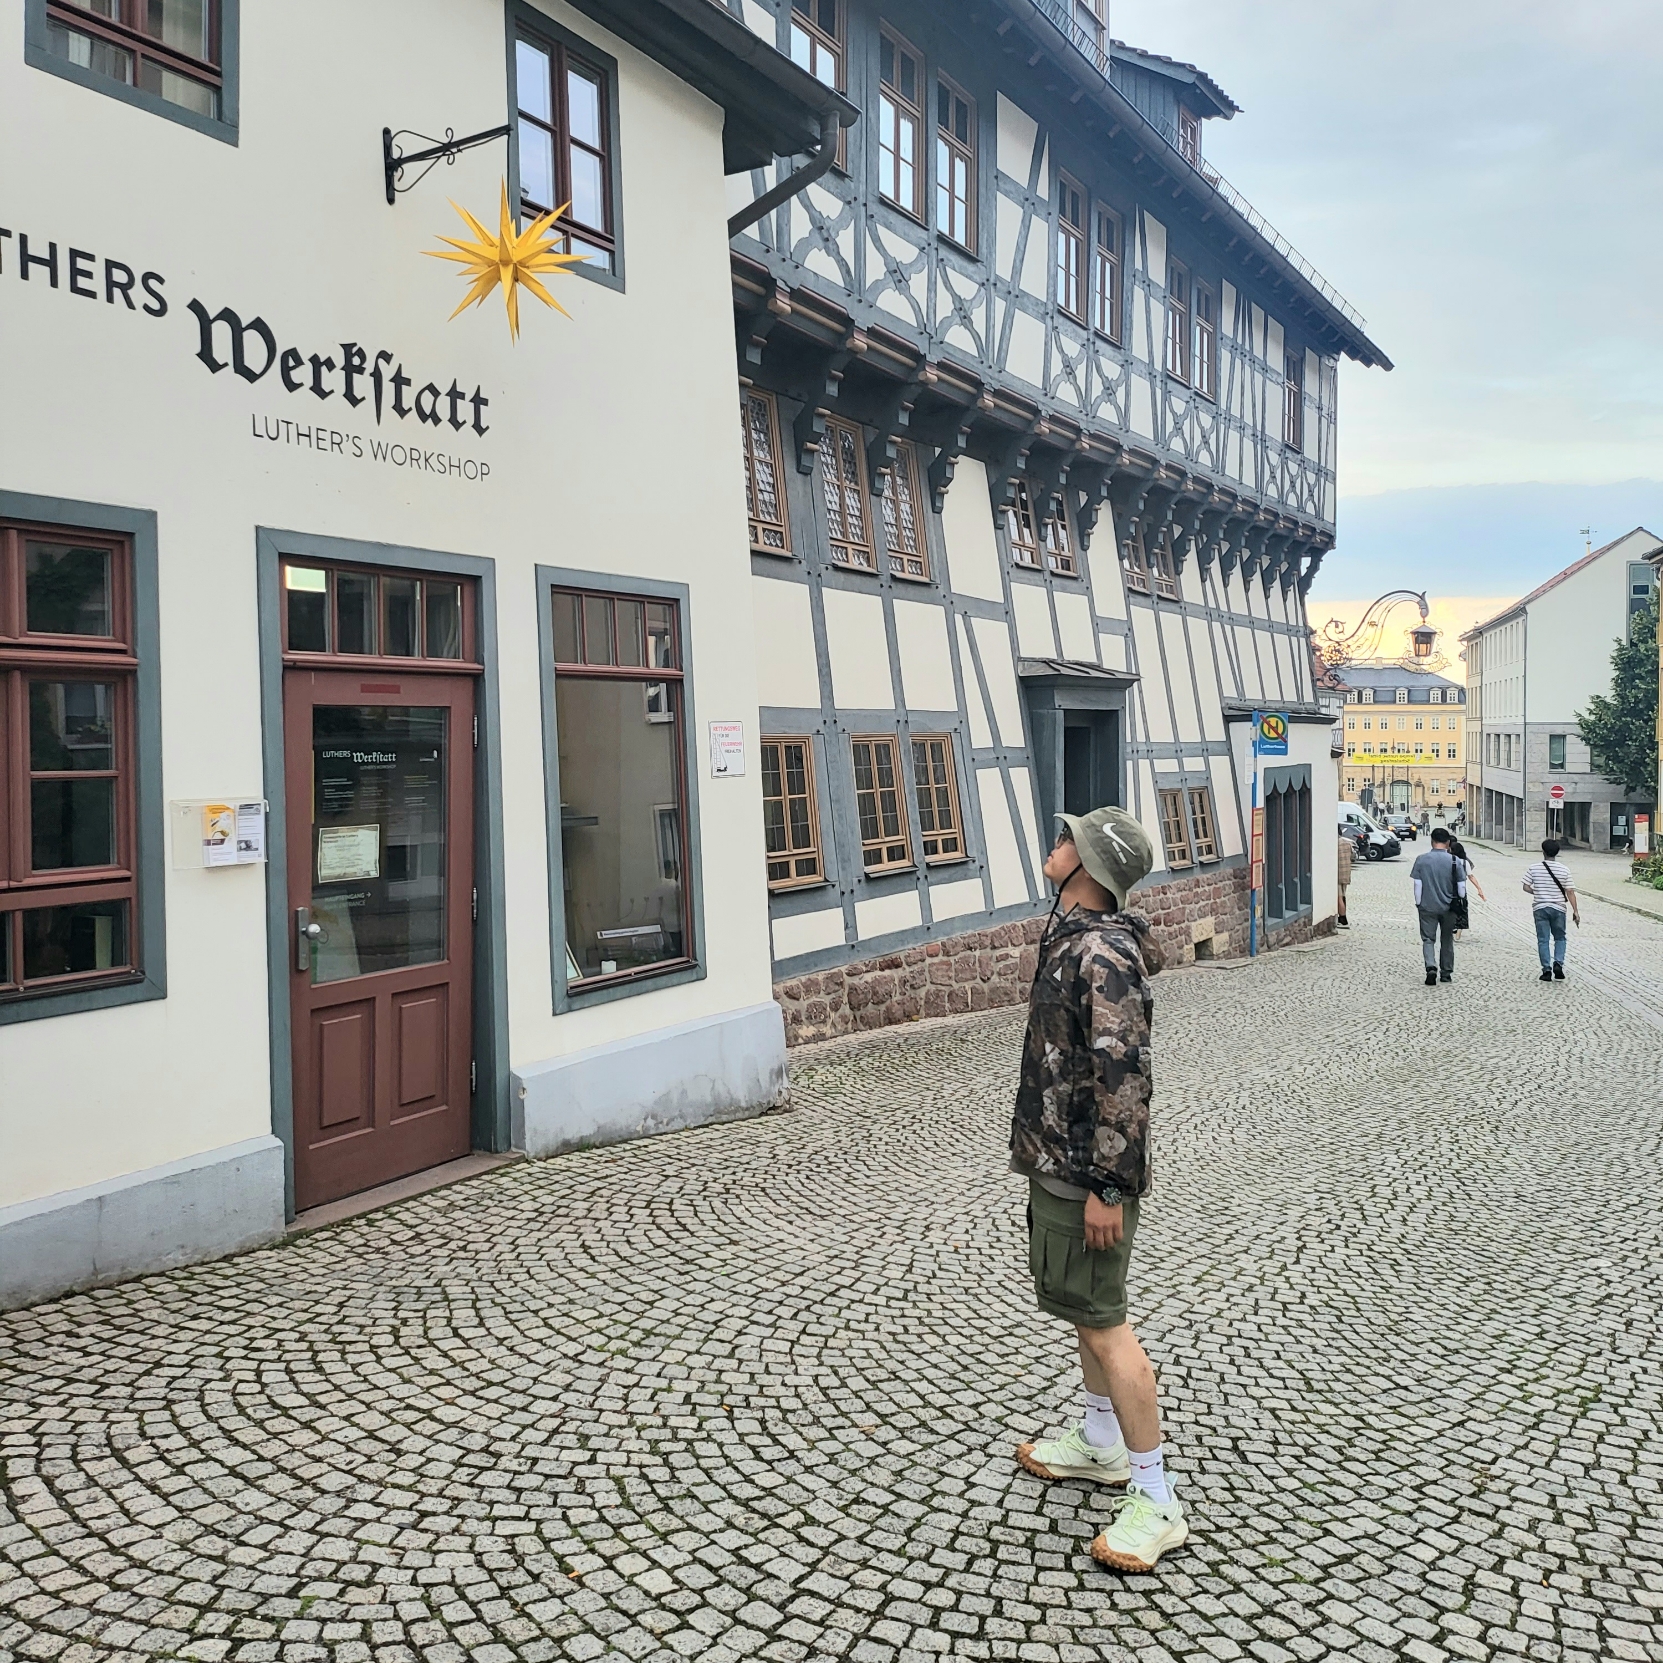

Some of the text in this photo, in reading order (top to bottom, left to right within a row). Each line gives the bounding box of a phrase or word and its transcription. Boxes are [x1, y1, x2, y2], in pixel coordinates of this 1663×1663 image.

[252, 412, 491, 482] LUTHER'S WORKSHOP
[322, 750, 351, 758] LUTHERS
